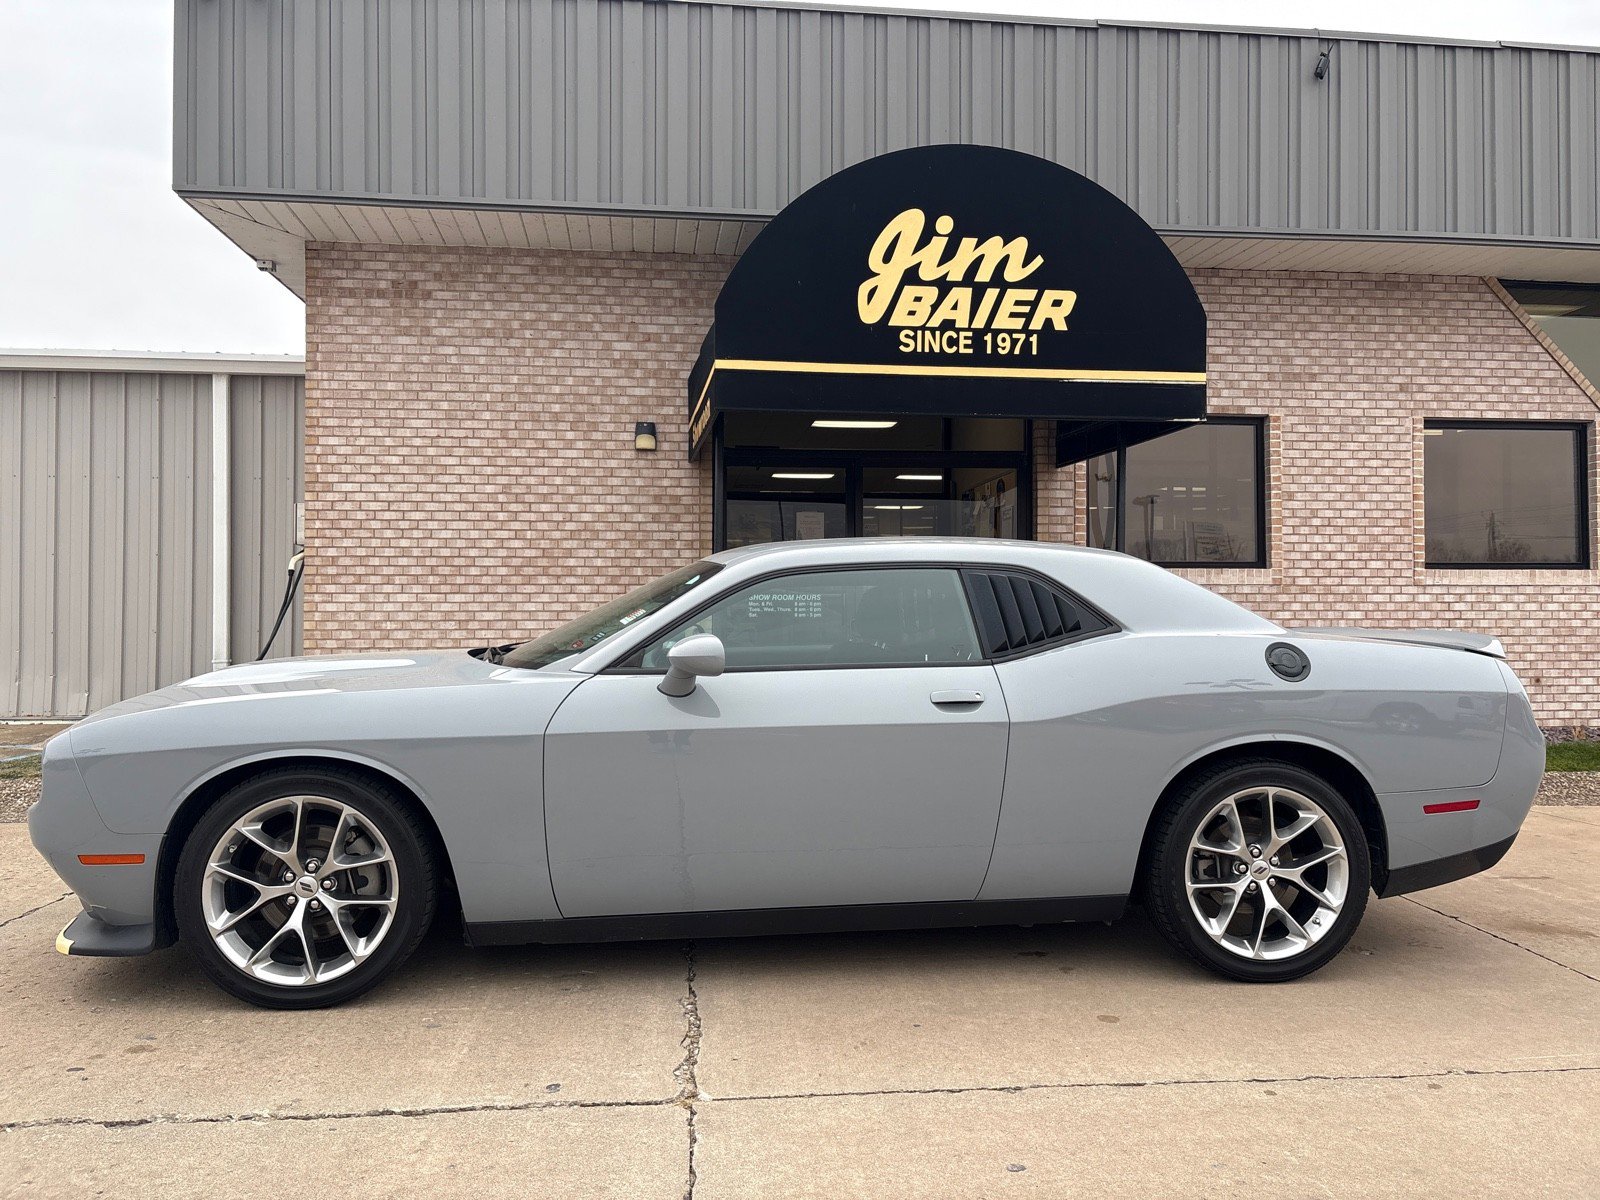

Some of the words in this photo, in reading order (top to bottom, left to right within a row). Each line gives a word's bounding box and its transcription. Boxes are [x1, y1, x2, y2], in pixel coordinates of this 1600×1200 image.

[858, 208, 1044, 324] Jim
[888, 285, 1077, 331] BAIER
[899, 330, 974, 354] SINCE
[984, 333, 1038, 355] 1971
